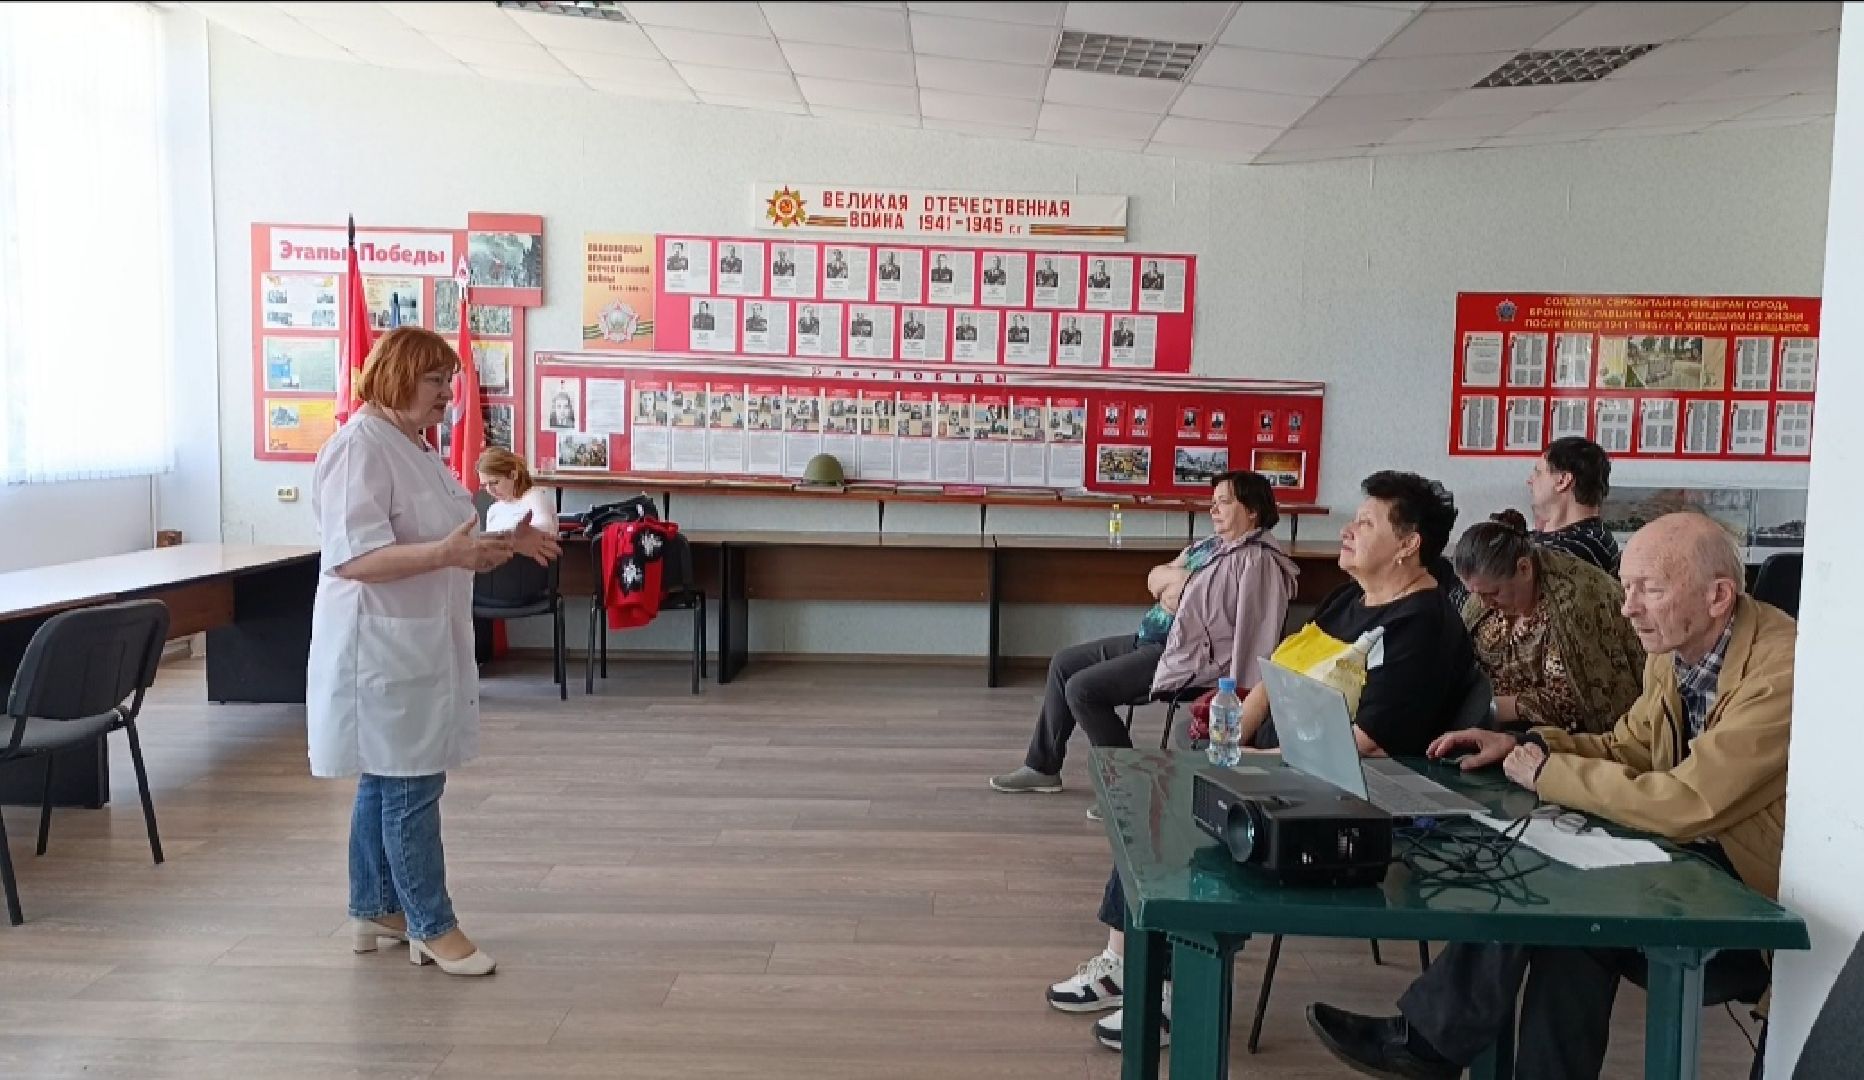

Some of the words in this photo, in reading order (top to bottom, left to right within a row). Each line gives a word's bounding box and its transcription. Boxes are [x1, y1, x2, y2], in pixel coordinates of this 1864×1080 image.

[823, 190, 908, 211] ВЕЛИКАЯ
[924, 195, 1070, 217] ОТЕЧЕСТВЕННАЯ
[919, 214, 1003, 233] 1941-1945
[279, 239, 347, 261] Этапы
[359, 242, 445, 266] Победы
[1682, 299, 1744, 310] ОФИЦЕРАМ
[1746, 300, 1789, 310] ГОРОДА
[1525, 318, 1561, 328] ПОСЛЕ
[1684, 322, 1728, 331] ЖИВЫМ
[1730, 322, 1809, 333] ПОСВЯЩАЕТСЯ
[1748, 312, 1763, 321] ИЗ
[1765, 312, 1804, 322] ЖИЗНИ
